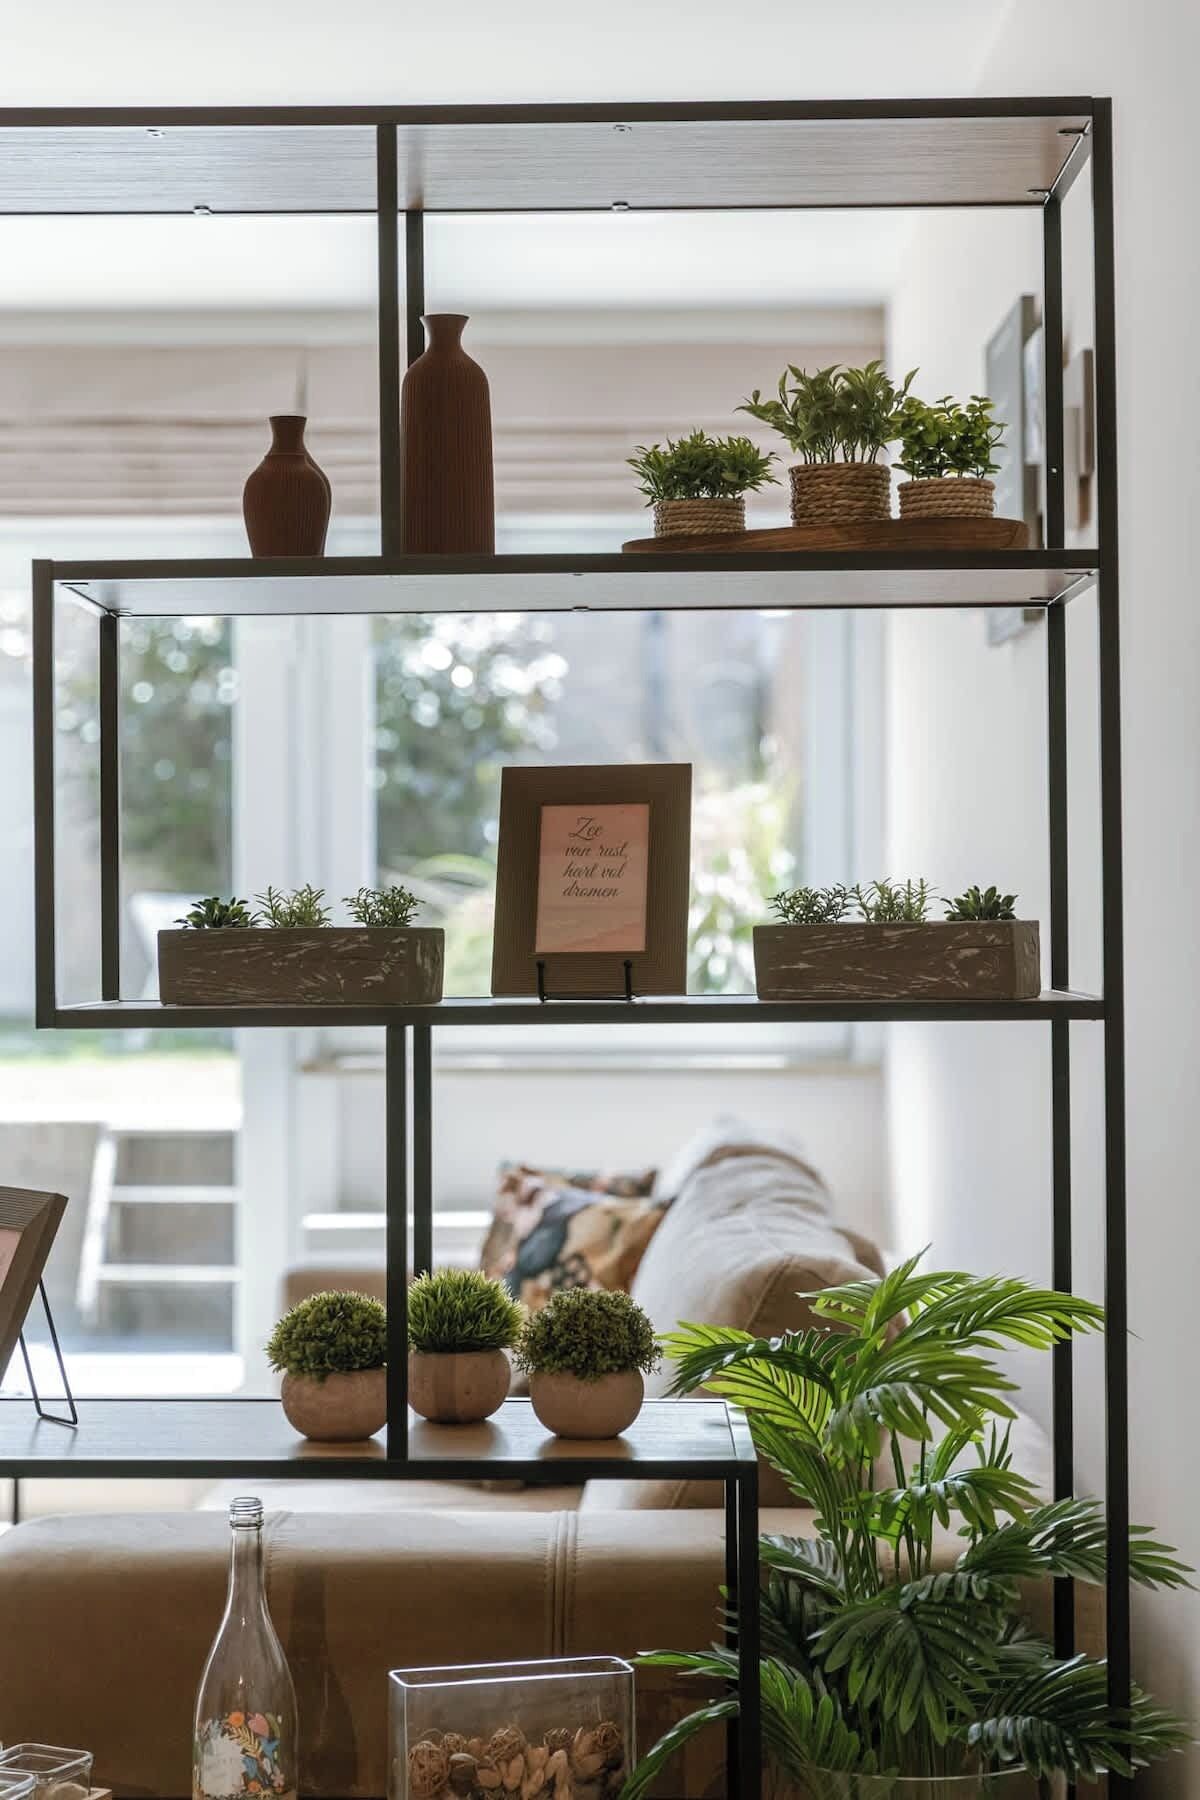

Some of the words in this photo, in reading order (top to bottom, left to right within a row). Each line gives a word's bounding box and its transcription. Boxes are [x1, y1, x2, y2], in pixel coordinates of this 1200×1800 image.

[568, 816, 604, 841] Zee
[565, 845, 592, 857] van
[562, 861, 598, 878] hart
[601, 862, 628, 879] vol
[562, 880, 622, 897] dromen
